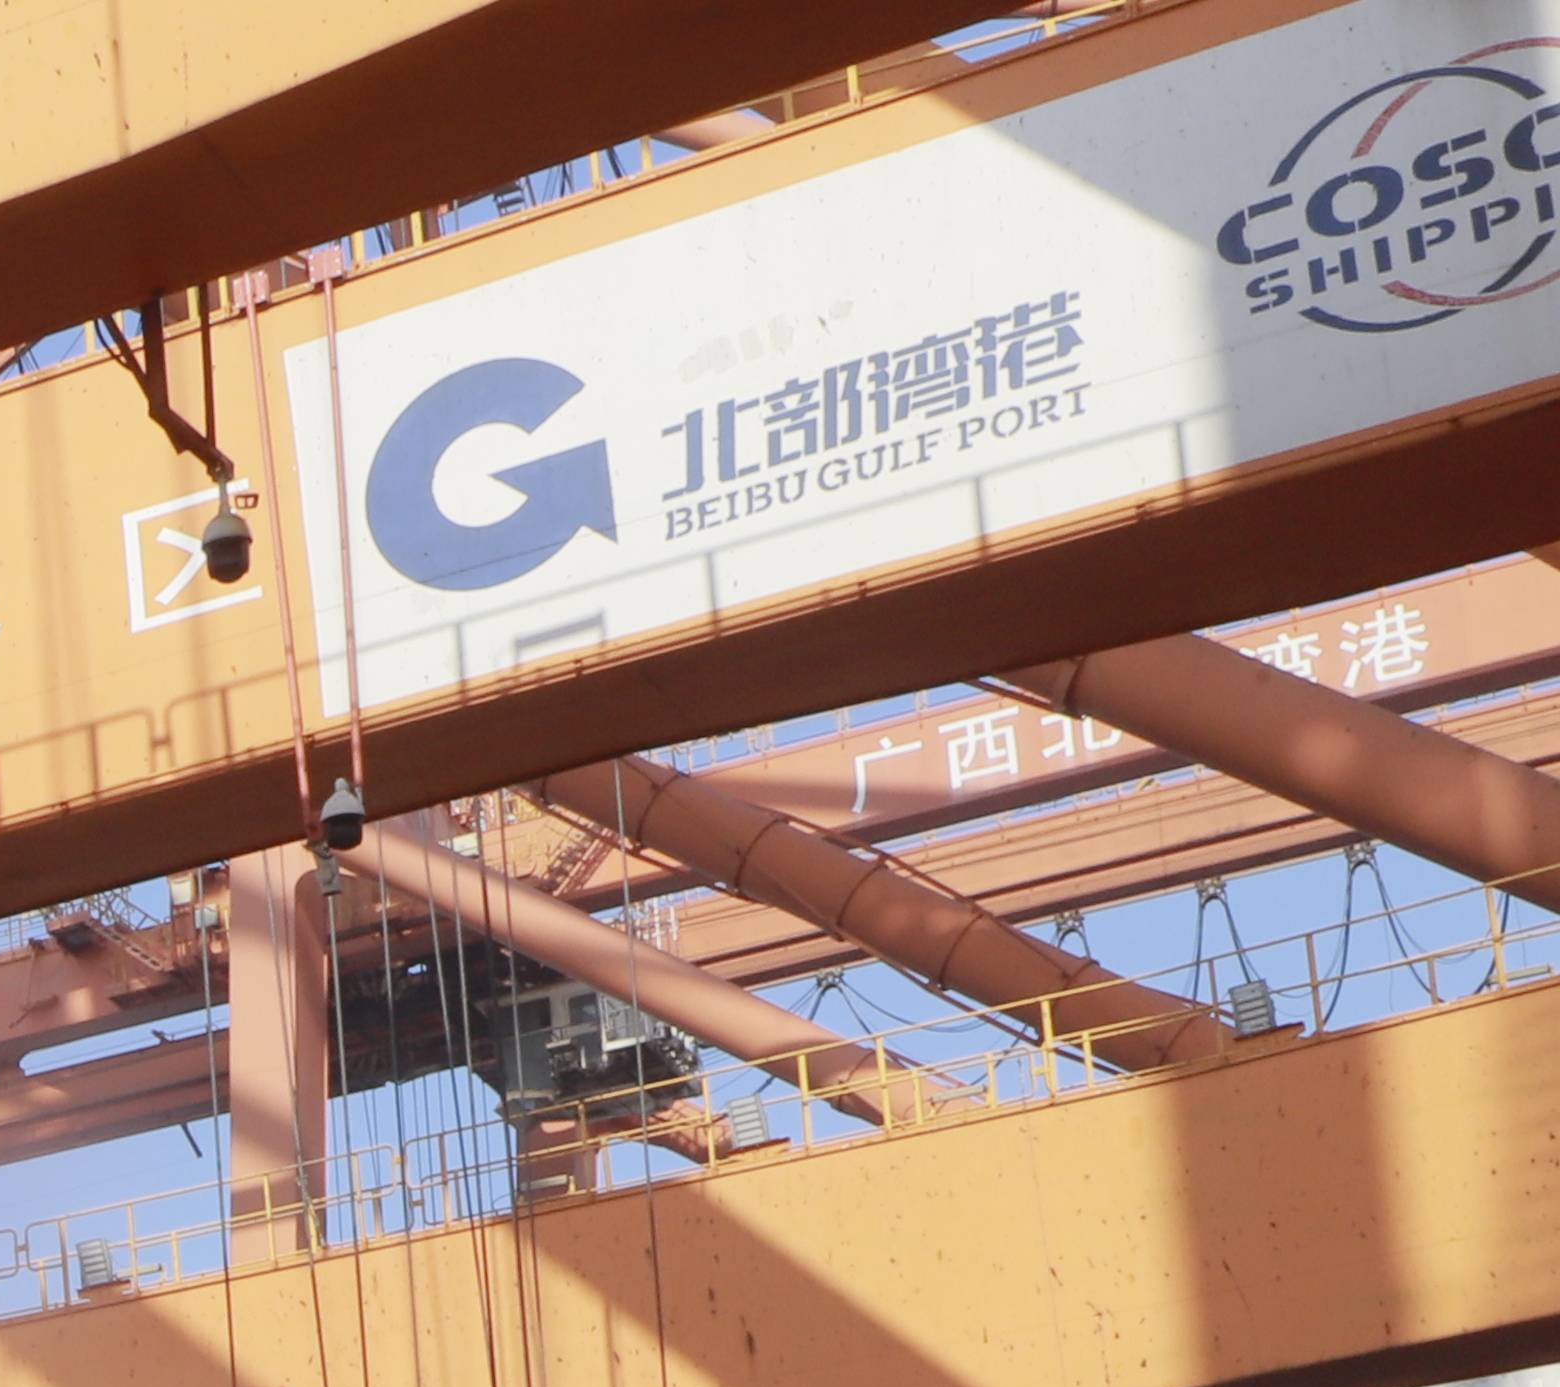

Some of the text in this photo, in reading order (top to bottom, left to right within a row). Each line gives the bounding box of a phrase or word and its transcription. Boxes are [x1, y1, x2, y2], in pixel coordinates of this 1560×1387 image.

[661, 291, 1085, 502] 北部湾港
[664, 382, 1093, 541] BEIBU GULF PORT
